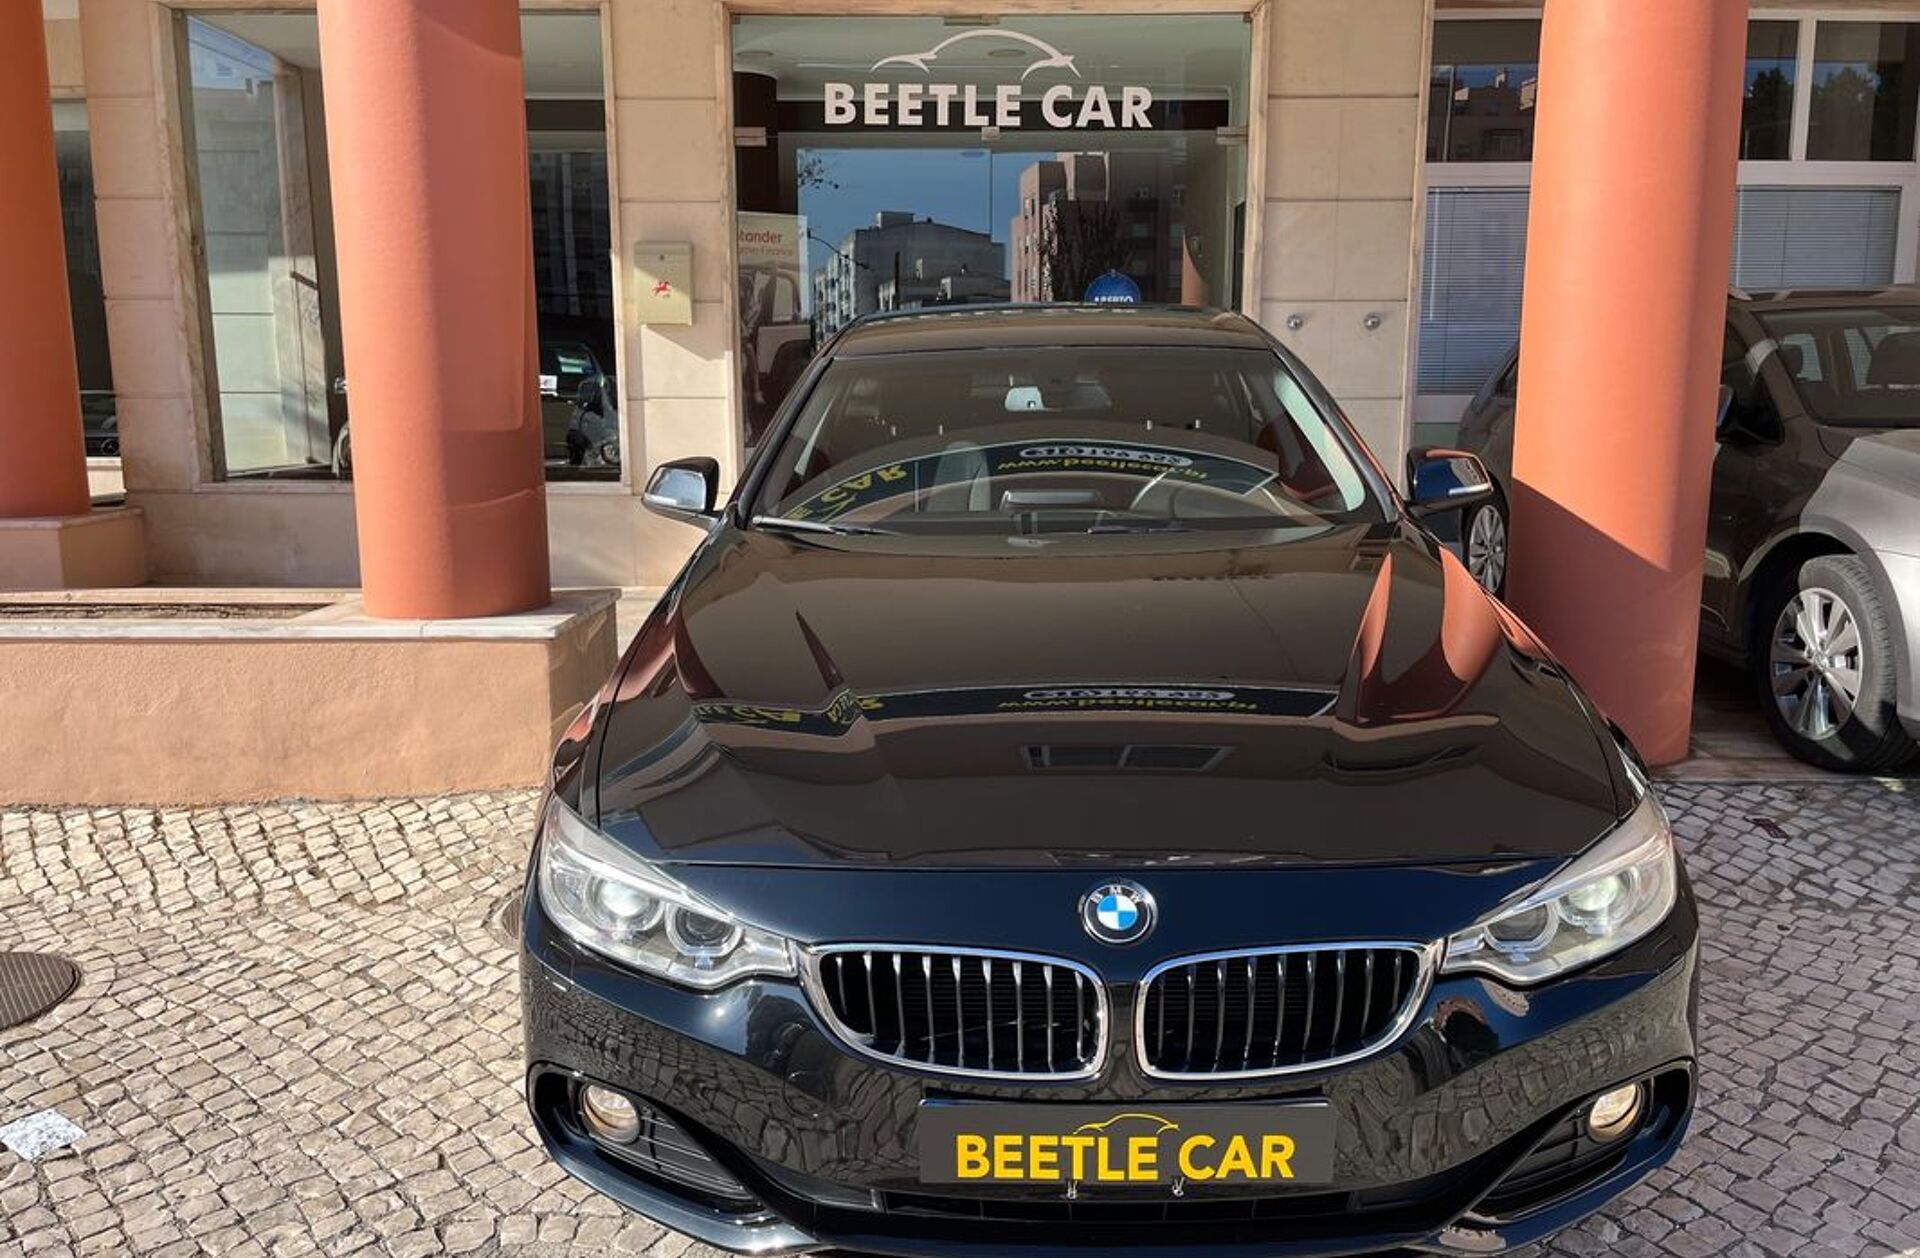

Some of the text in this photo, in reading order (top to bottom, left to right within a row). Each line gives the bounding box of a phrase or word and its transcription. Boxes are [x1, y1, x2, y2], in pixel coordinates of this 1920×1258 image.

[824, 82, 1153, 128] BEETLE CAR
[739, 229, 783, 243] tander
[956, 1134, 1295, 1181] BEETLE CAR
